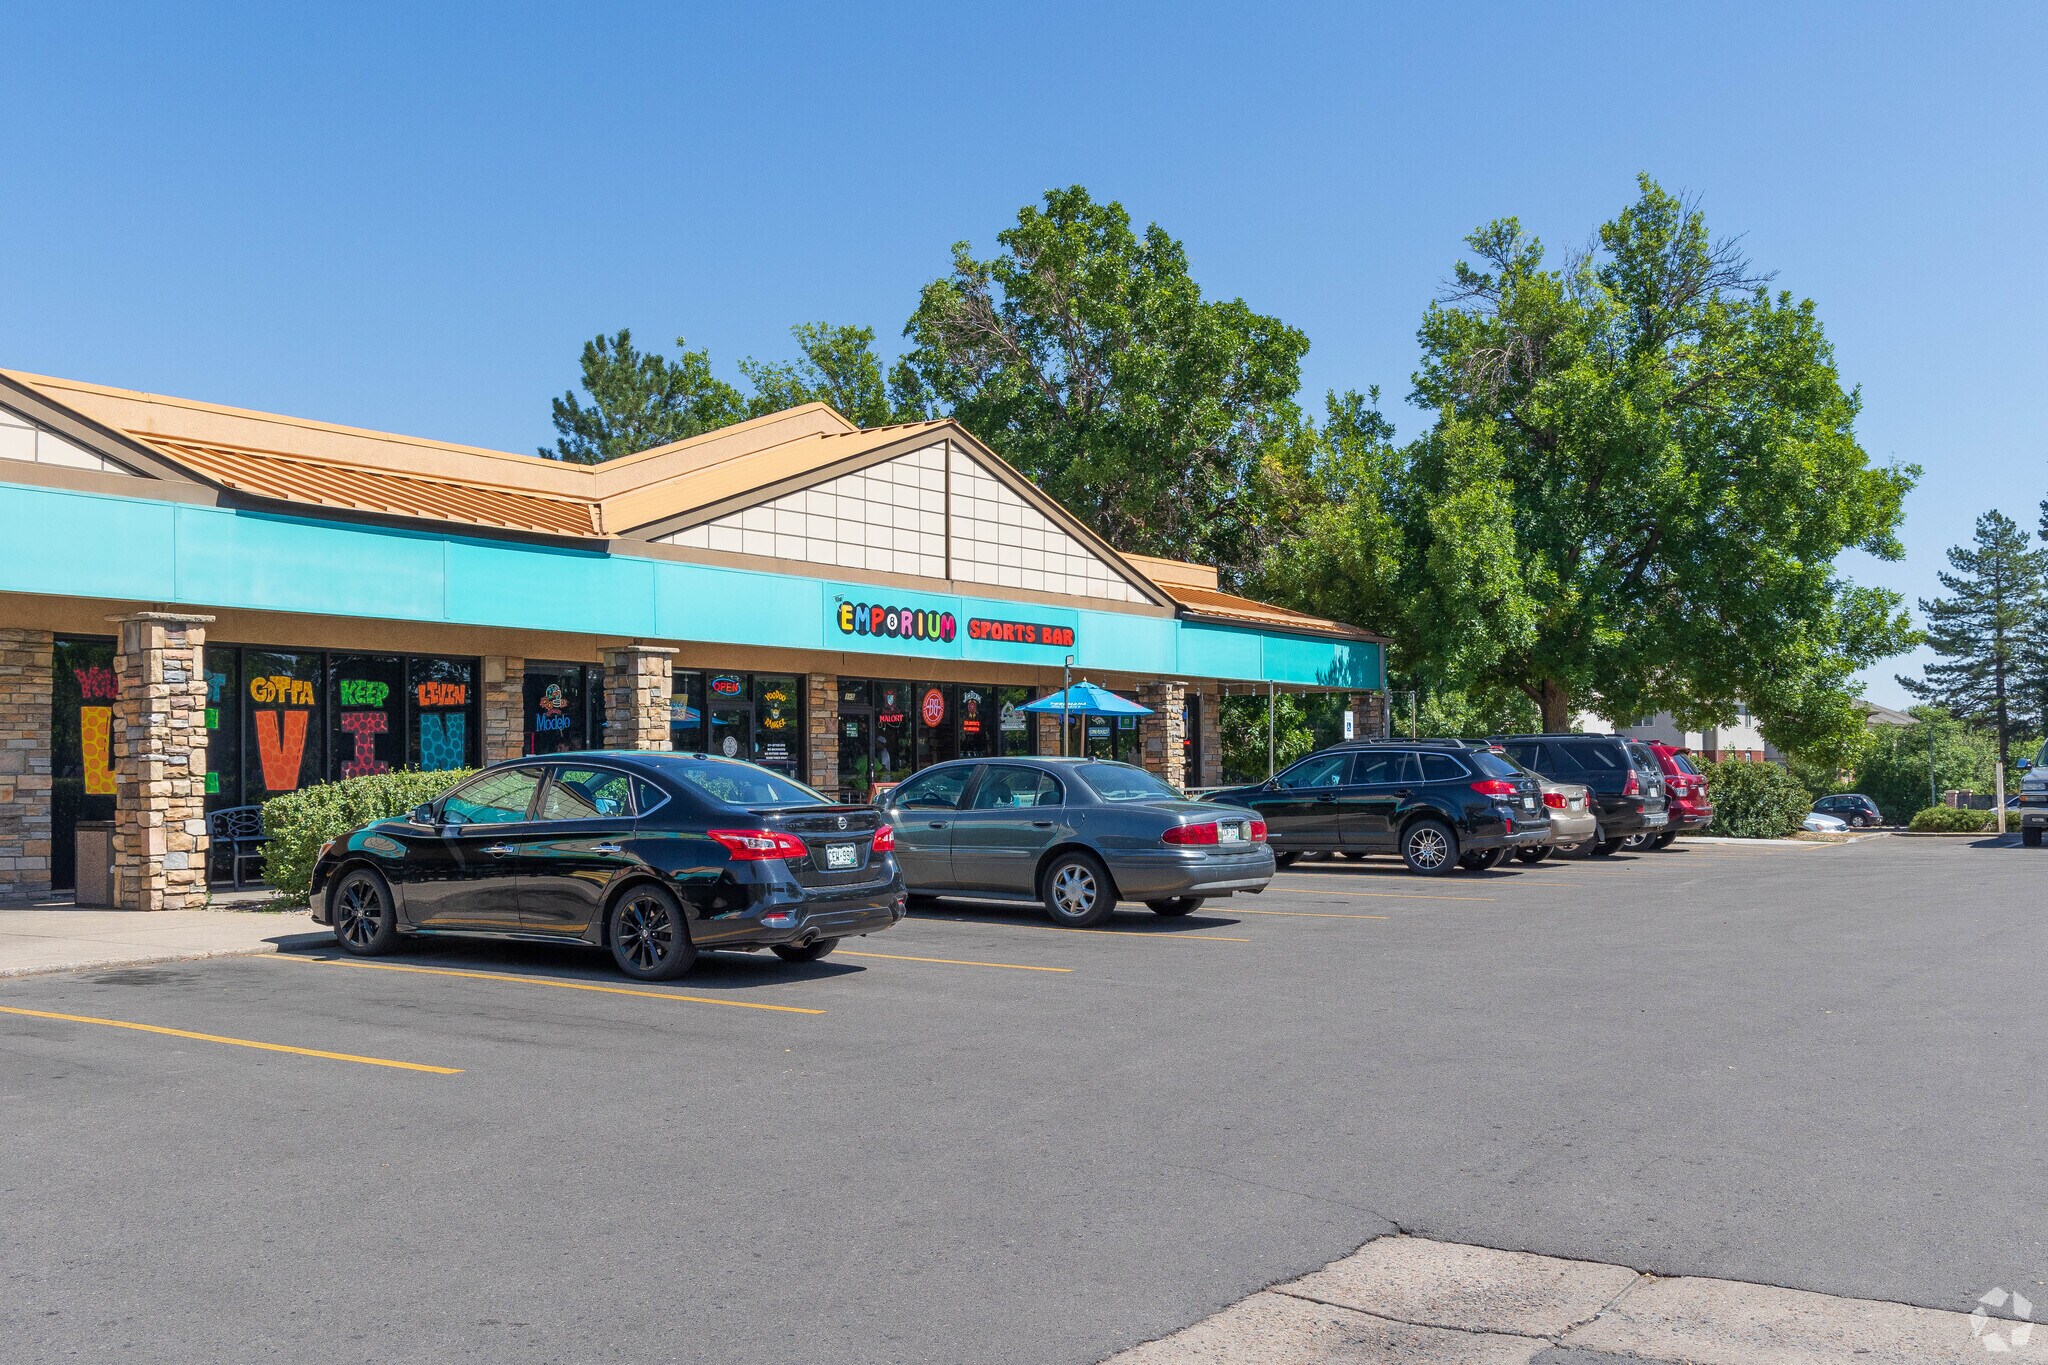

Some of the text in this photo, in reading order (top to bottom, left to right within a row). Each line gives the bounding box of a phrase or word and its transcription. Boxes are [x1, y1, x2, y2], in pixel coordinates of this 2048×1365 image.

[969, 619, 1073, 646] SPORTS BAR
[250, 675, 315, 705] GOTTA
[340, 679, 389, 708] KEEP
[418, 681, 466, 707] LIVIN
[713, 681, 738, 693] OPEN
[764, 690, 787, 702] VOODOO
[536, 714, 571, 732] Modelo
[764, 717, 787, 730] RANGER
